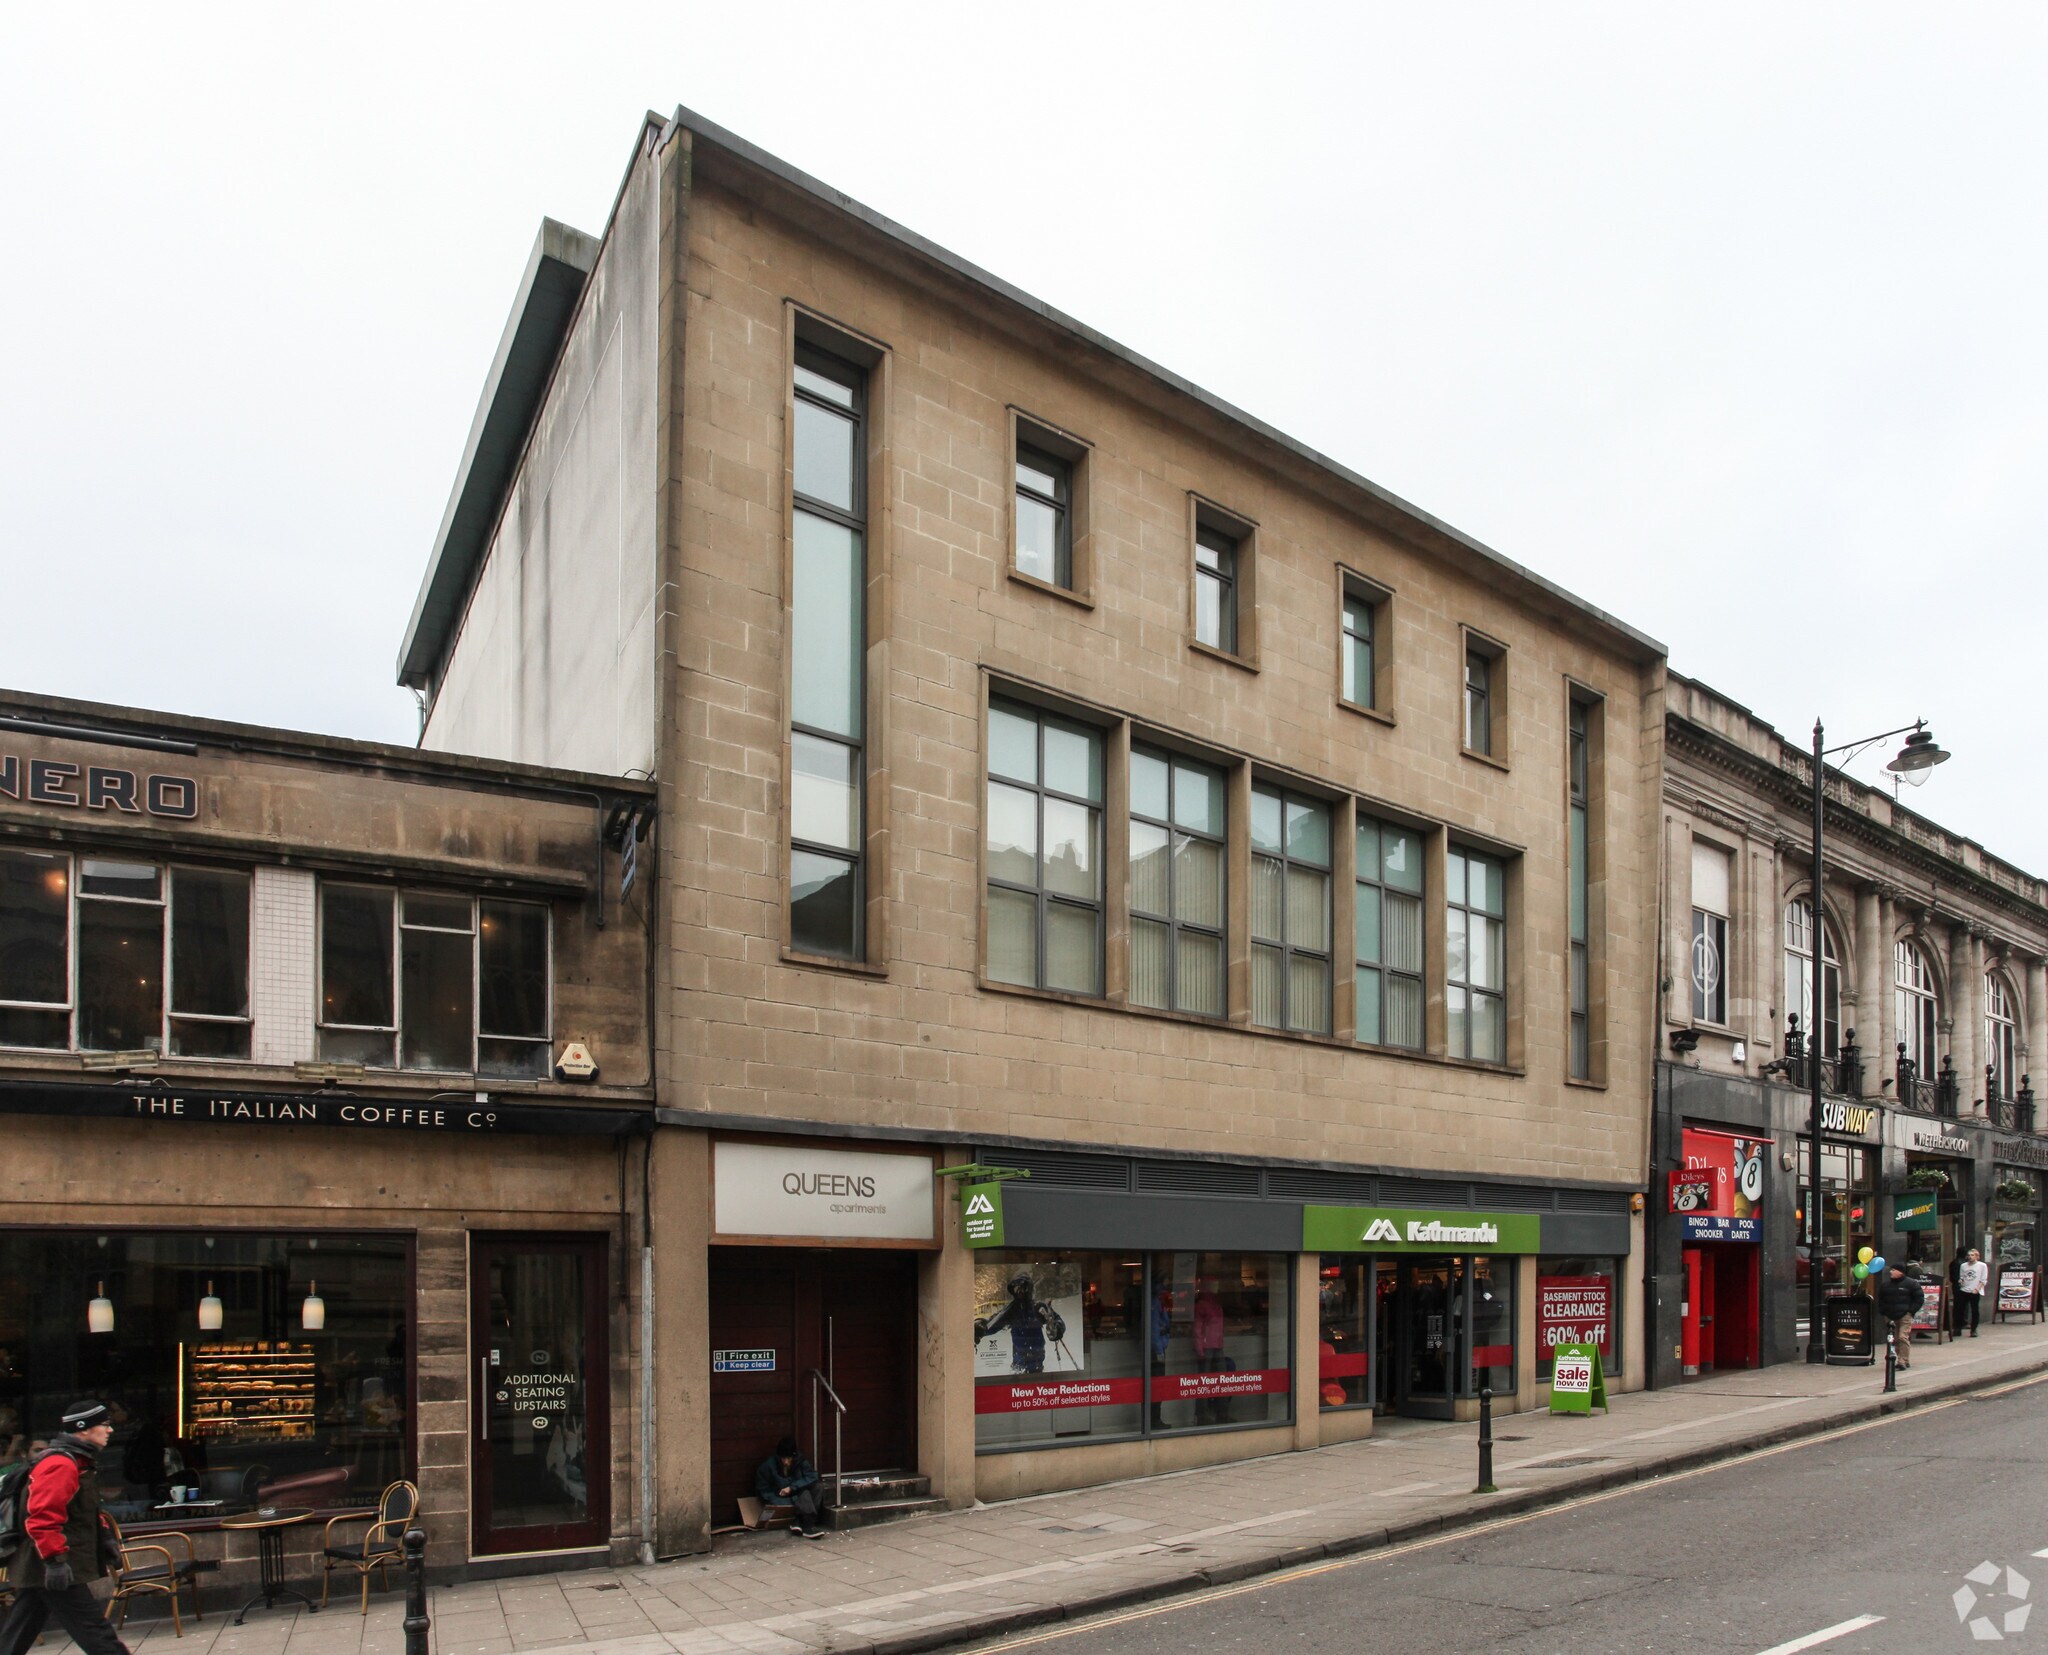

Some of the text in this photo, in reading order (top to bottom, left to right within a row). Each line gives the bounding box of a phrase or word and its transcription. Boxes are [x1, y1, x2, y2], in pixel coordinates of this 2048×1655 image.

[133, 1096, 184, 1114] THE
[210, 1100, 316, 1119] ITALIAN
[340, 1106, 445, 1126] COFFEE
[1820, 1103, 1875, 1134] SUBWAY
[1681, 1173, 1705, 1183] Rileys
[782, 1172, 876, 1198] QUEENS
[829, 1203, 887, 1214] apartments
[1895, 1203, 1934, 1221] SUBWAY
[1688, 1217, 1754, 1229] BINGO BAR POOL
[1407, 1220, 1497, 1243] Kathmandu
[1695, 1229, 1750, 1240] SNOOKER DARTS
[1543, 1292, 1606, 1301] BASEMENT STOCK
[1543, 1303, 1606, 1317] CLEARANCE
[1546, 1324, 1606, 1347] 60% off
[730, 1352, 749, 1360] Fire
[730, 1362, 749, 1370] Keep
[504, 1374, 576, 1385] ADDITIONAL
[1180, 1373, 1262, 1387] New Year Reductions
[1557, 1367, 1589, 1380] sale
[515, 1387, 565, 1398] SEATING
[1011, 1382, 1111, 1398] New Year Reductions
[1180, 1389, 1189, 1397] up
[1197, 1387, 1210, 1395] 50%
[1212, 1386, 1220, 1394] off
[1221, 1384, 1244, 1393] selected
[1246, 1383, 1262, 1391] styles
[514, 1400, 567, 1411] UPSTAIRS
[1011, 1401, 1022, 1409] up
[1032, 1398, 1048, 1407] 50%
[1050, 1396, 1060, 1405] off
[1061, 1395, 1090, 1405] selected
[1091, 1394, 1111, 1404] styles
